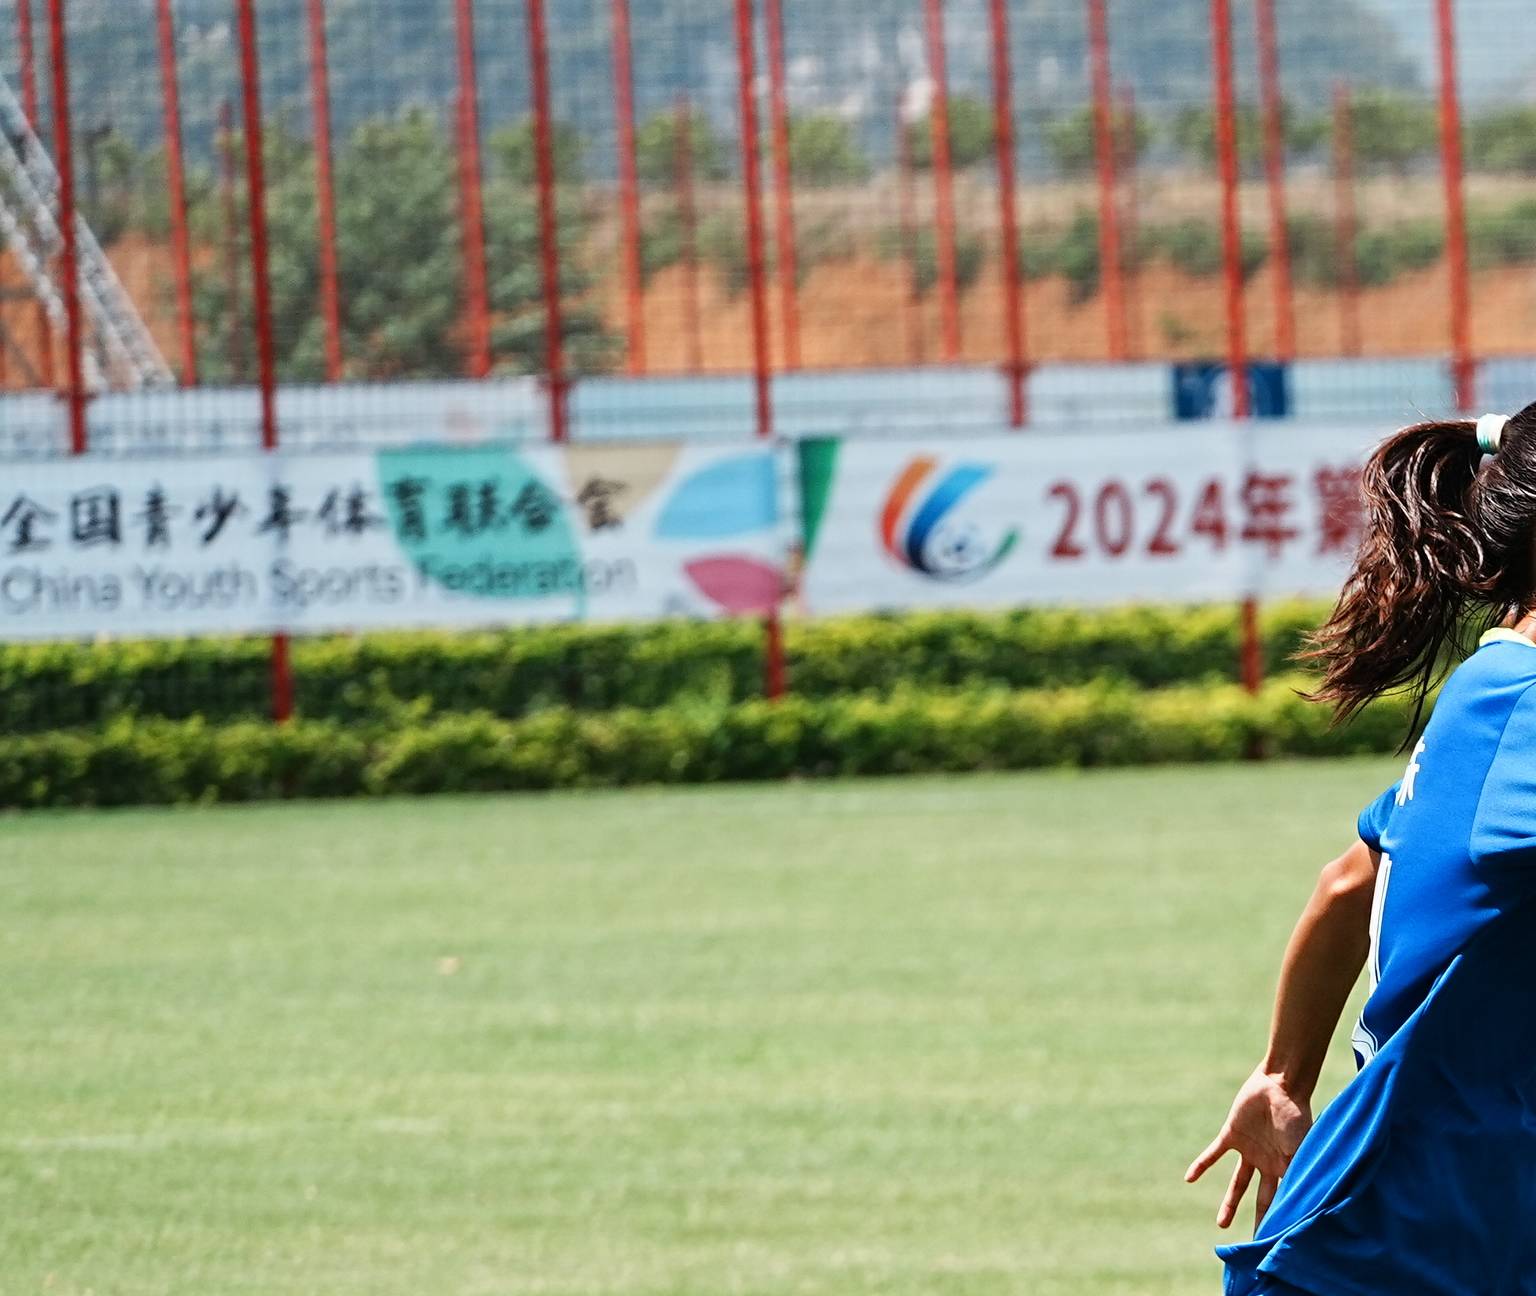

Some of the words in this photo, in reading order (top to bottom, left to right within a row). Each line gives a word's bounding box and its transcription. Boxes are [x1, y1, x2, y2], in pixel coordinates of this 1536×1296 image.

[0, 474, 630, 550] 全国青少年体育联合会
[1, 563, 122, 614] China
[130, 561, 258, 610] Youth
[270, 557, 405, 608] Sports
[414, 553, 638, 598] Federation
